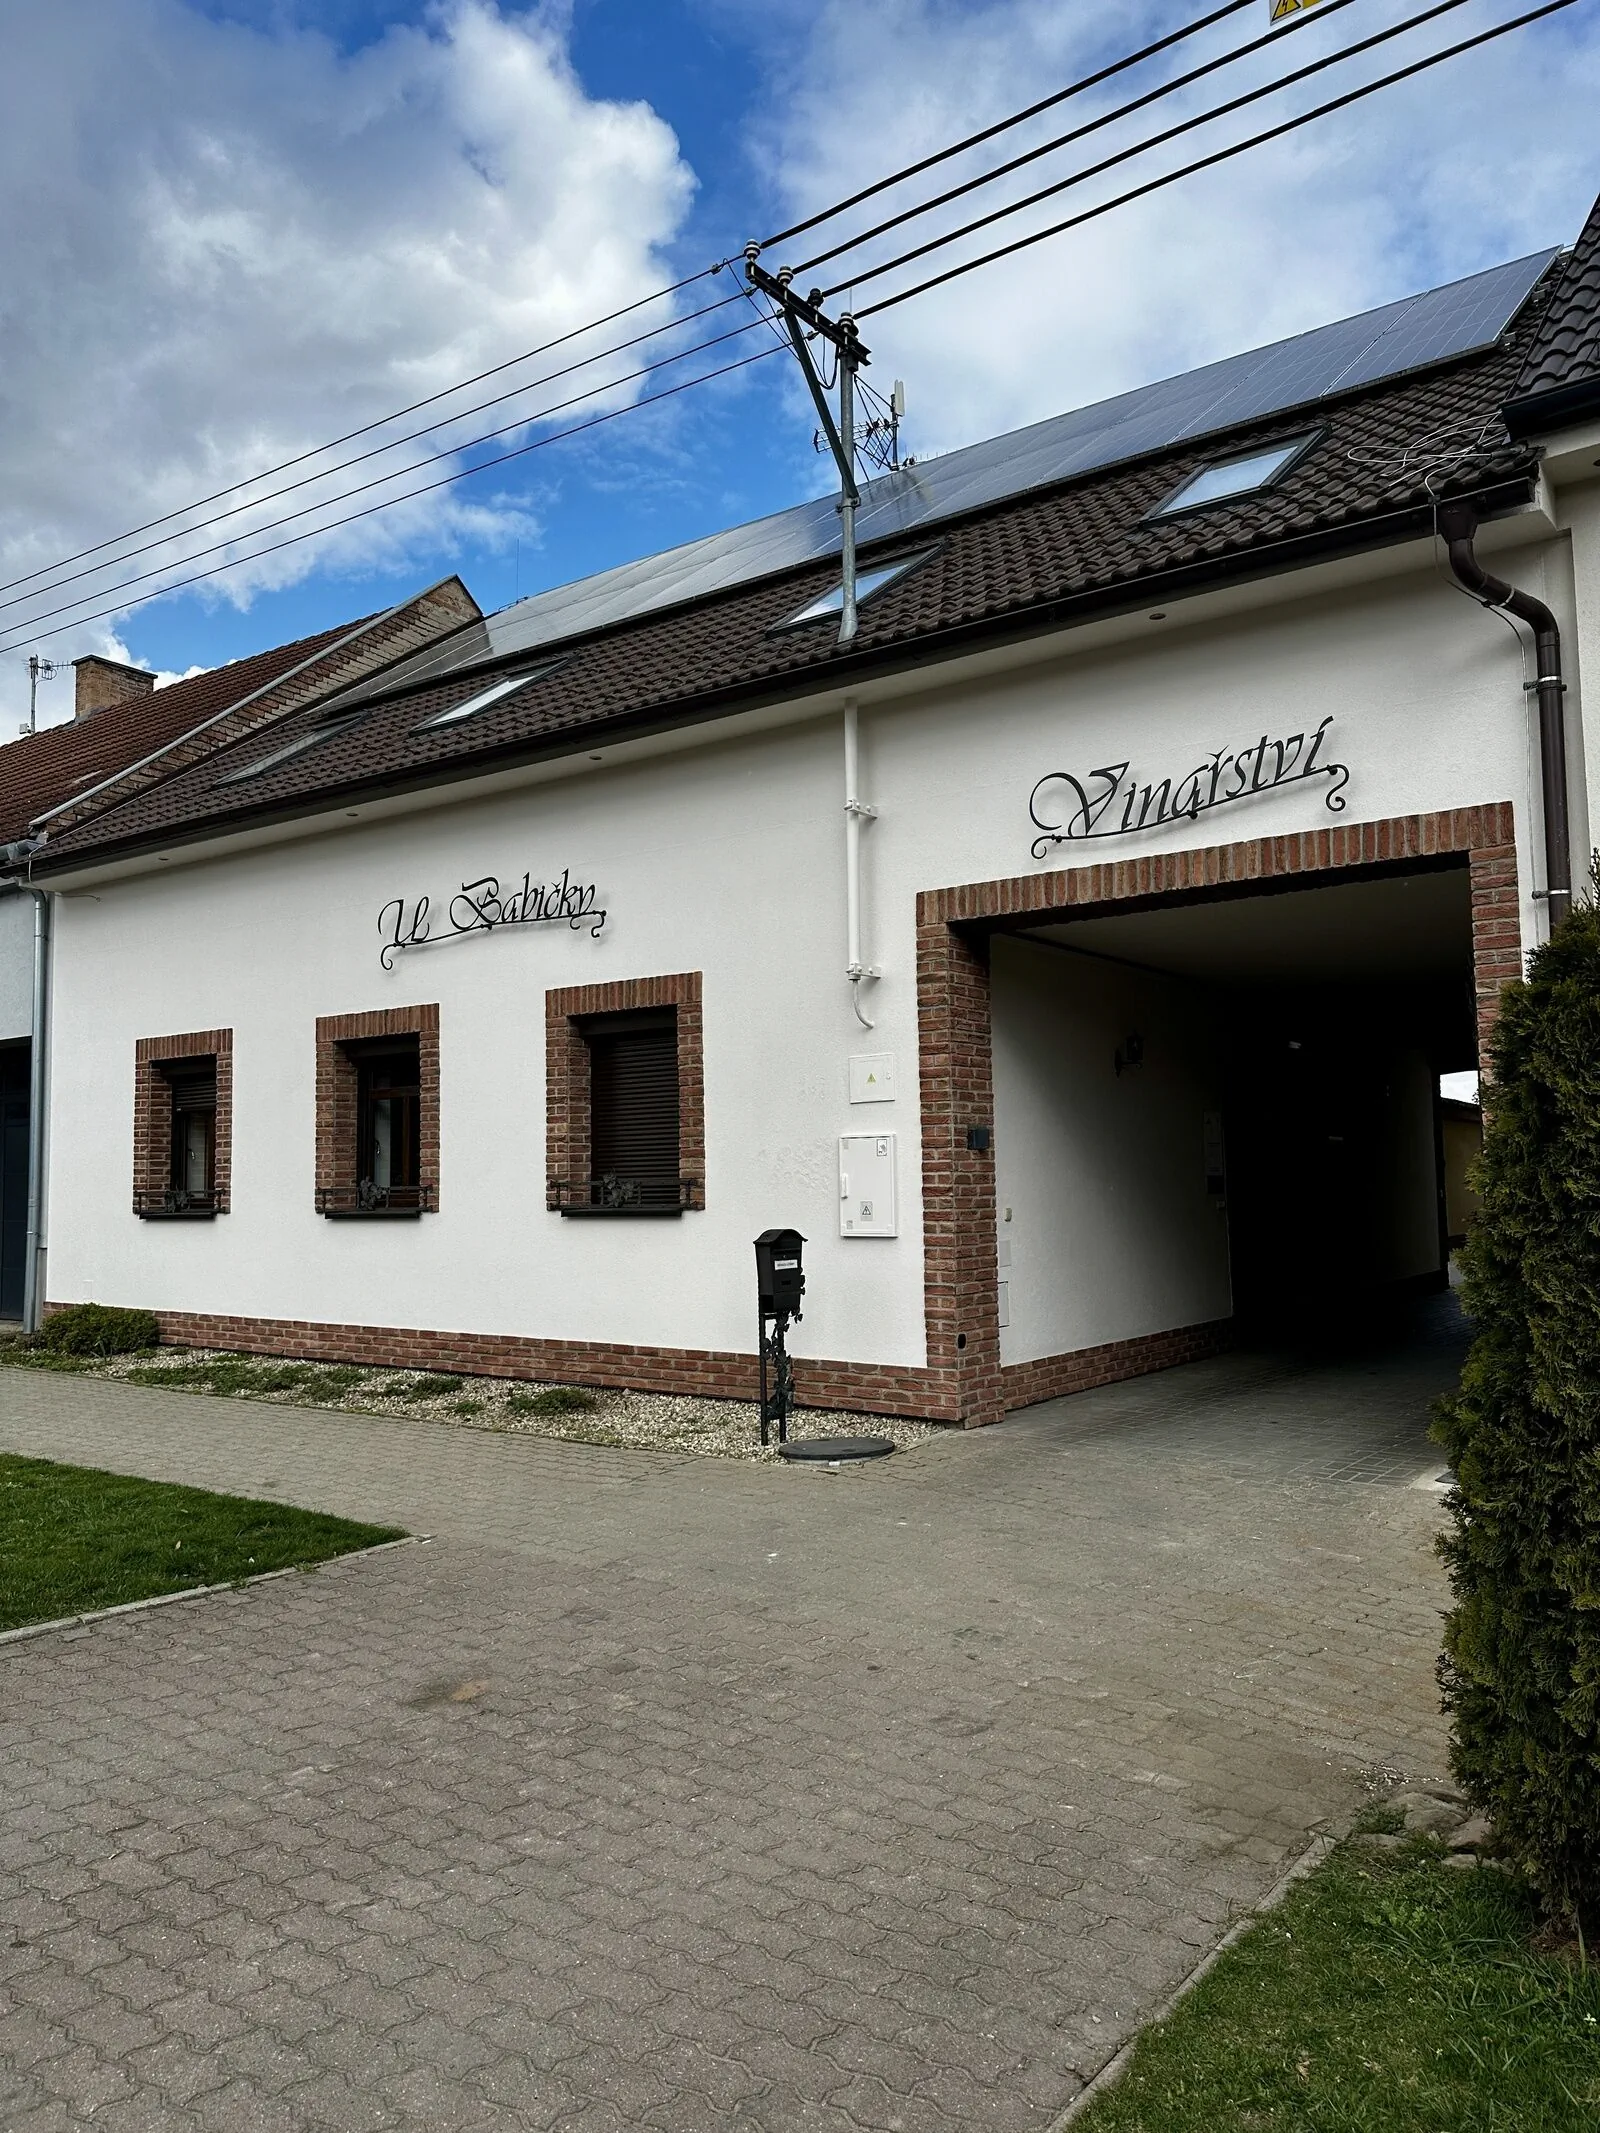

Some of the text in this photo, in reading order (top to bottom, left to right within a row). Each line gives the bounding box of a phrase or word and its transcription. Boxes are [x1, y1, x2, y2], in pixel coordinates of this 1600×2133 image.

[1030, 716, 1334, 837] Vinařství
[378, 868, 597, 945] U Babičky
